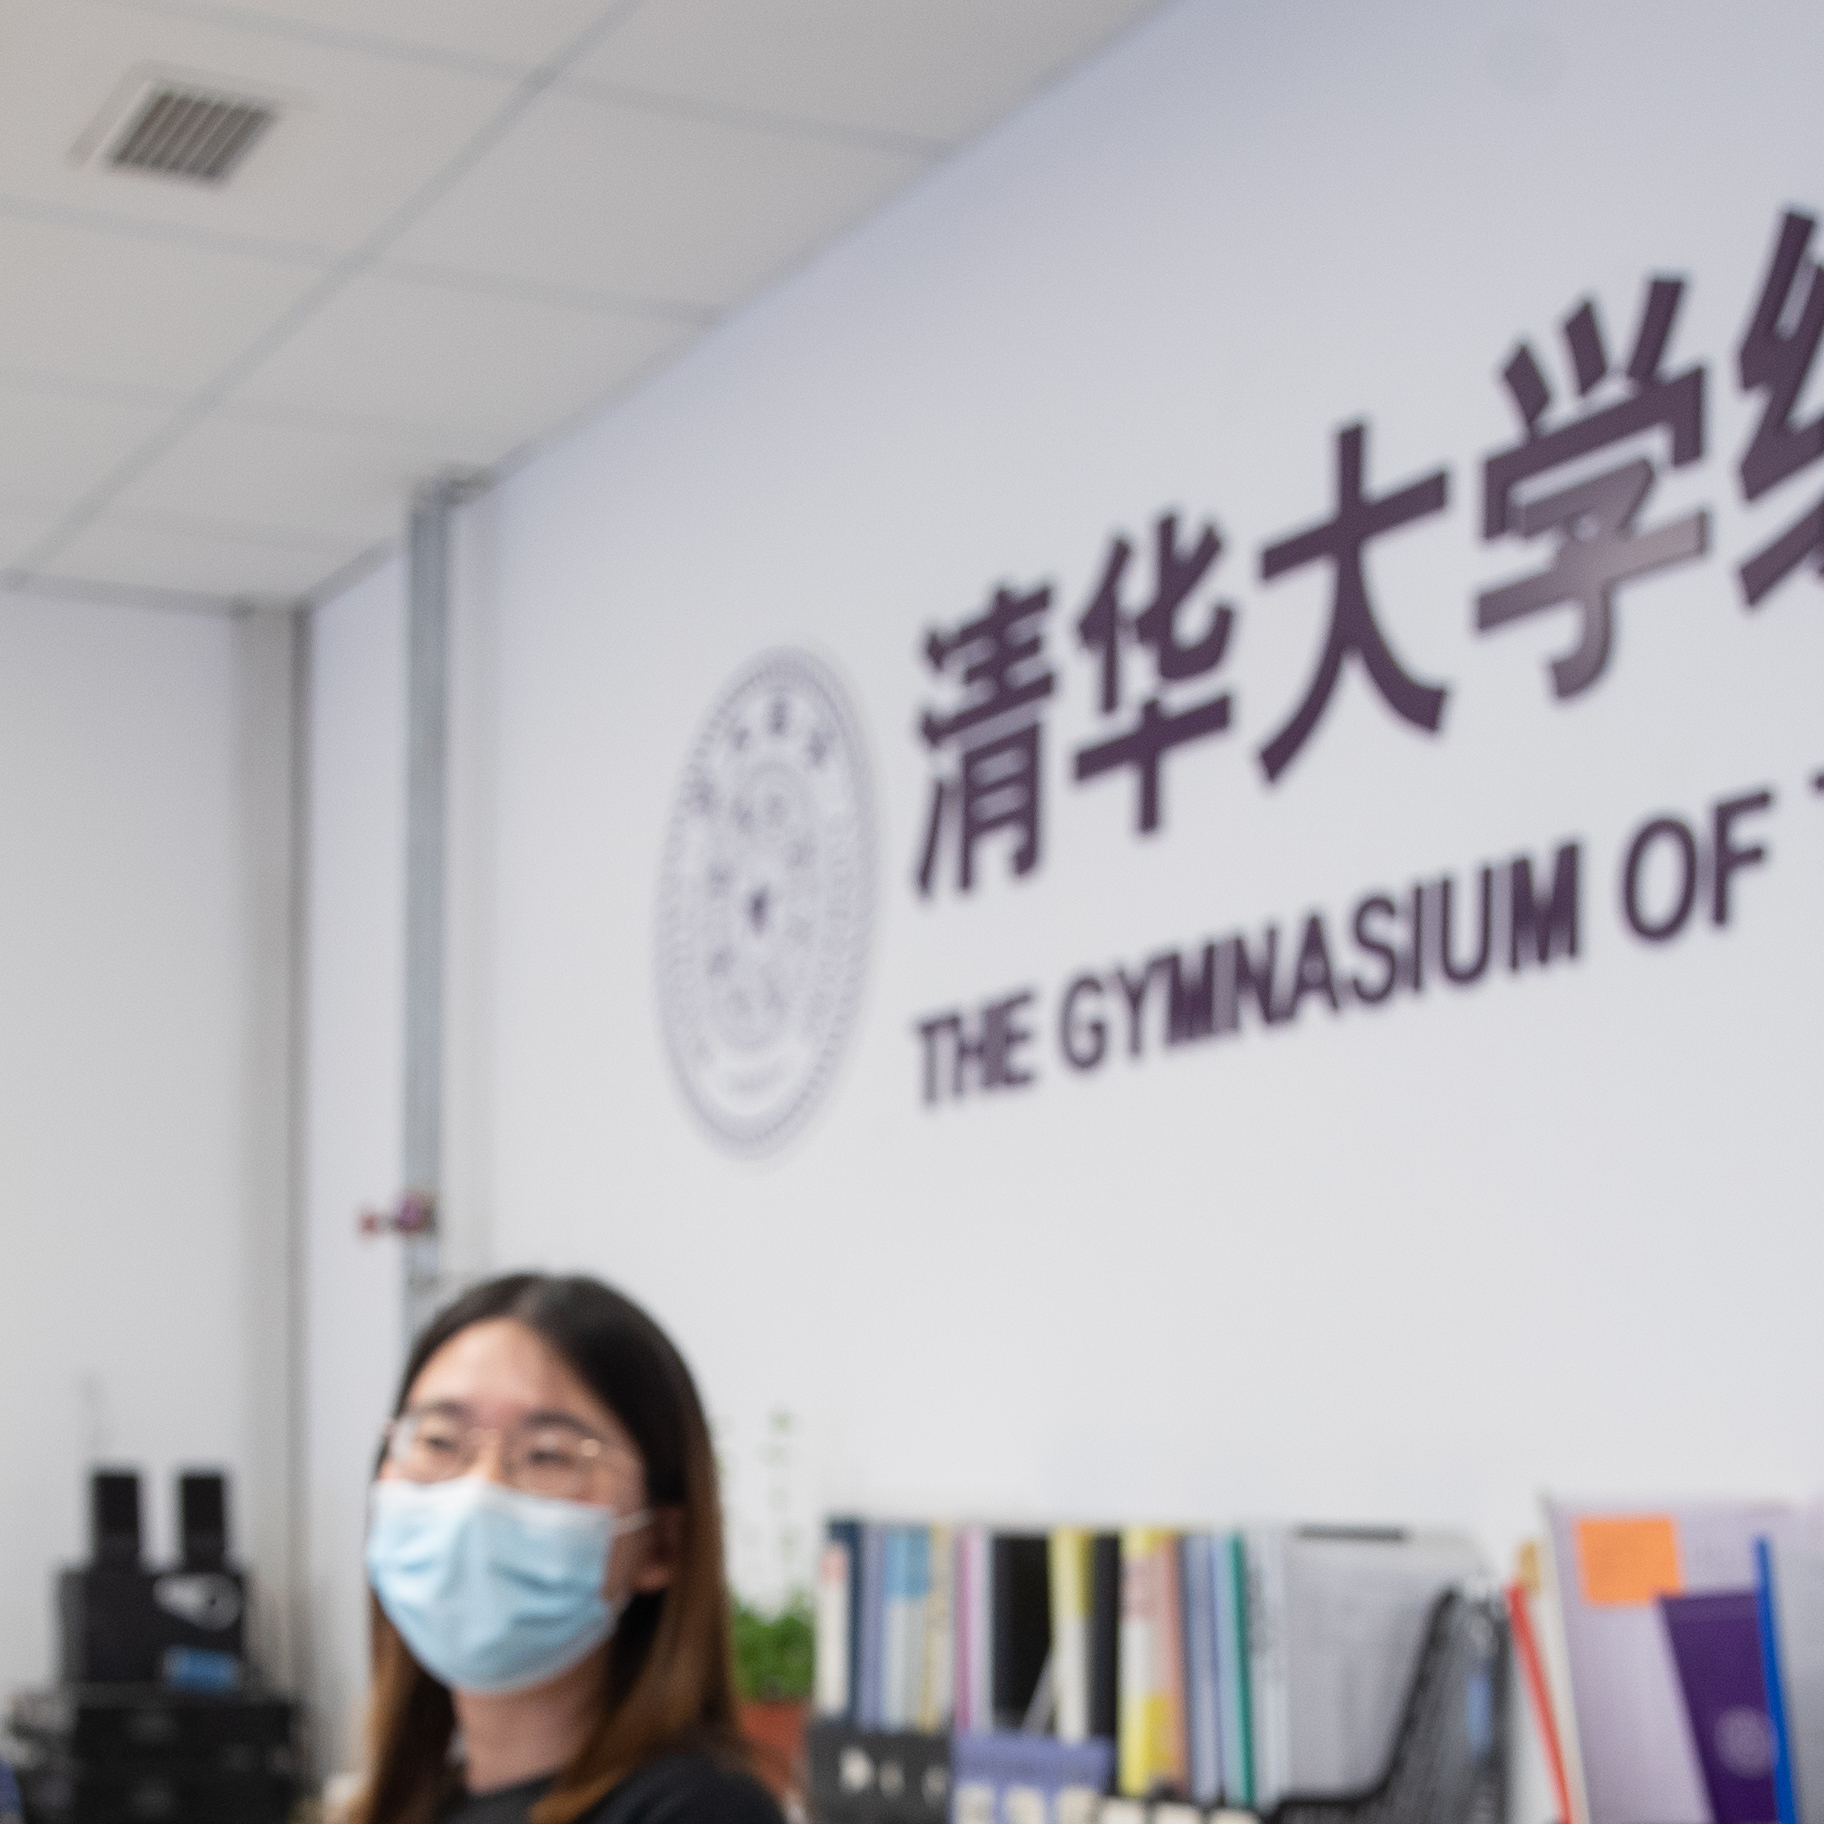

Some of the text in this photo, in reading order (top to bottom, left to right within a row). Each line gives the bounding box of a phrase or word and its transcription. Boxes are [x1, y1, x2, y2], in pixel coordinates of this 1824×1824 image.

[914, 987, 1038, 1109] THE
[1059, 836, 1585, 1075] GYMNASIUM
[1619, 782, 1775, 945] OF
